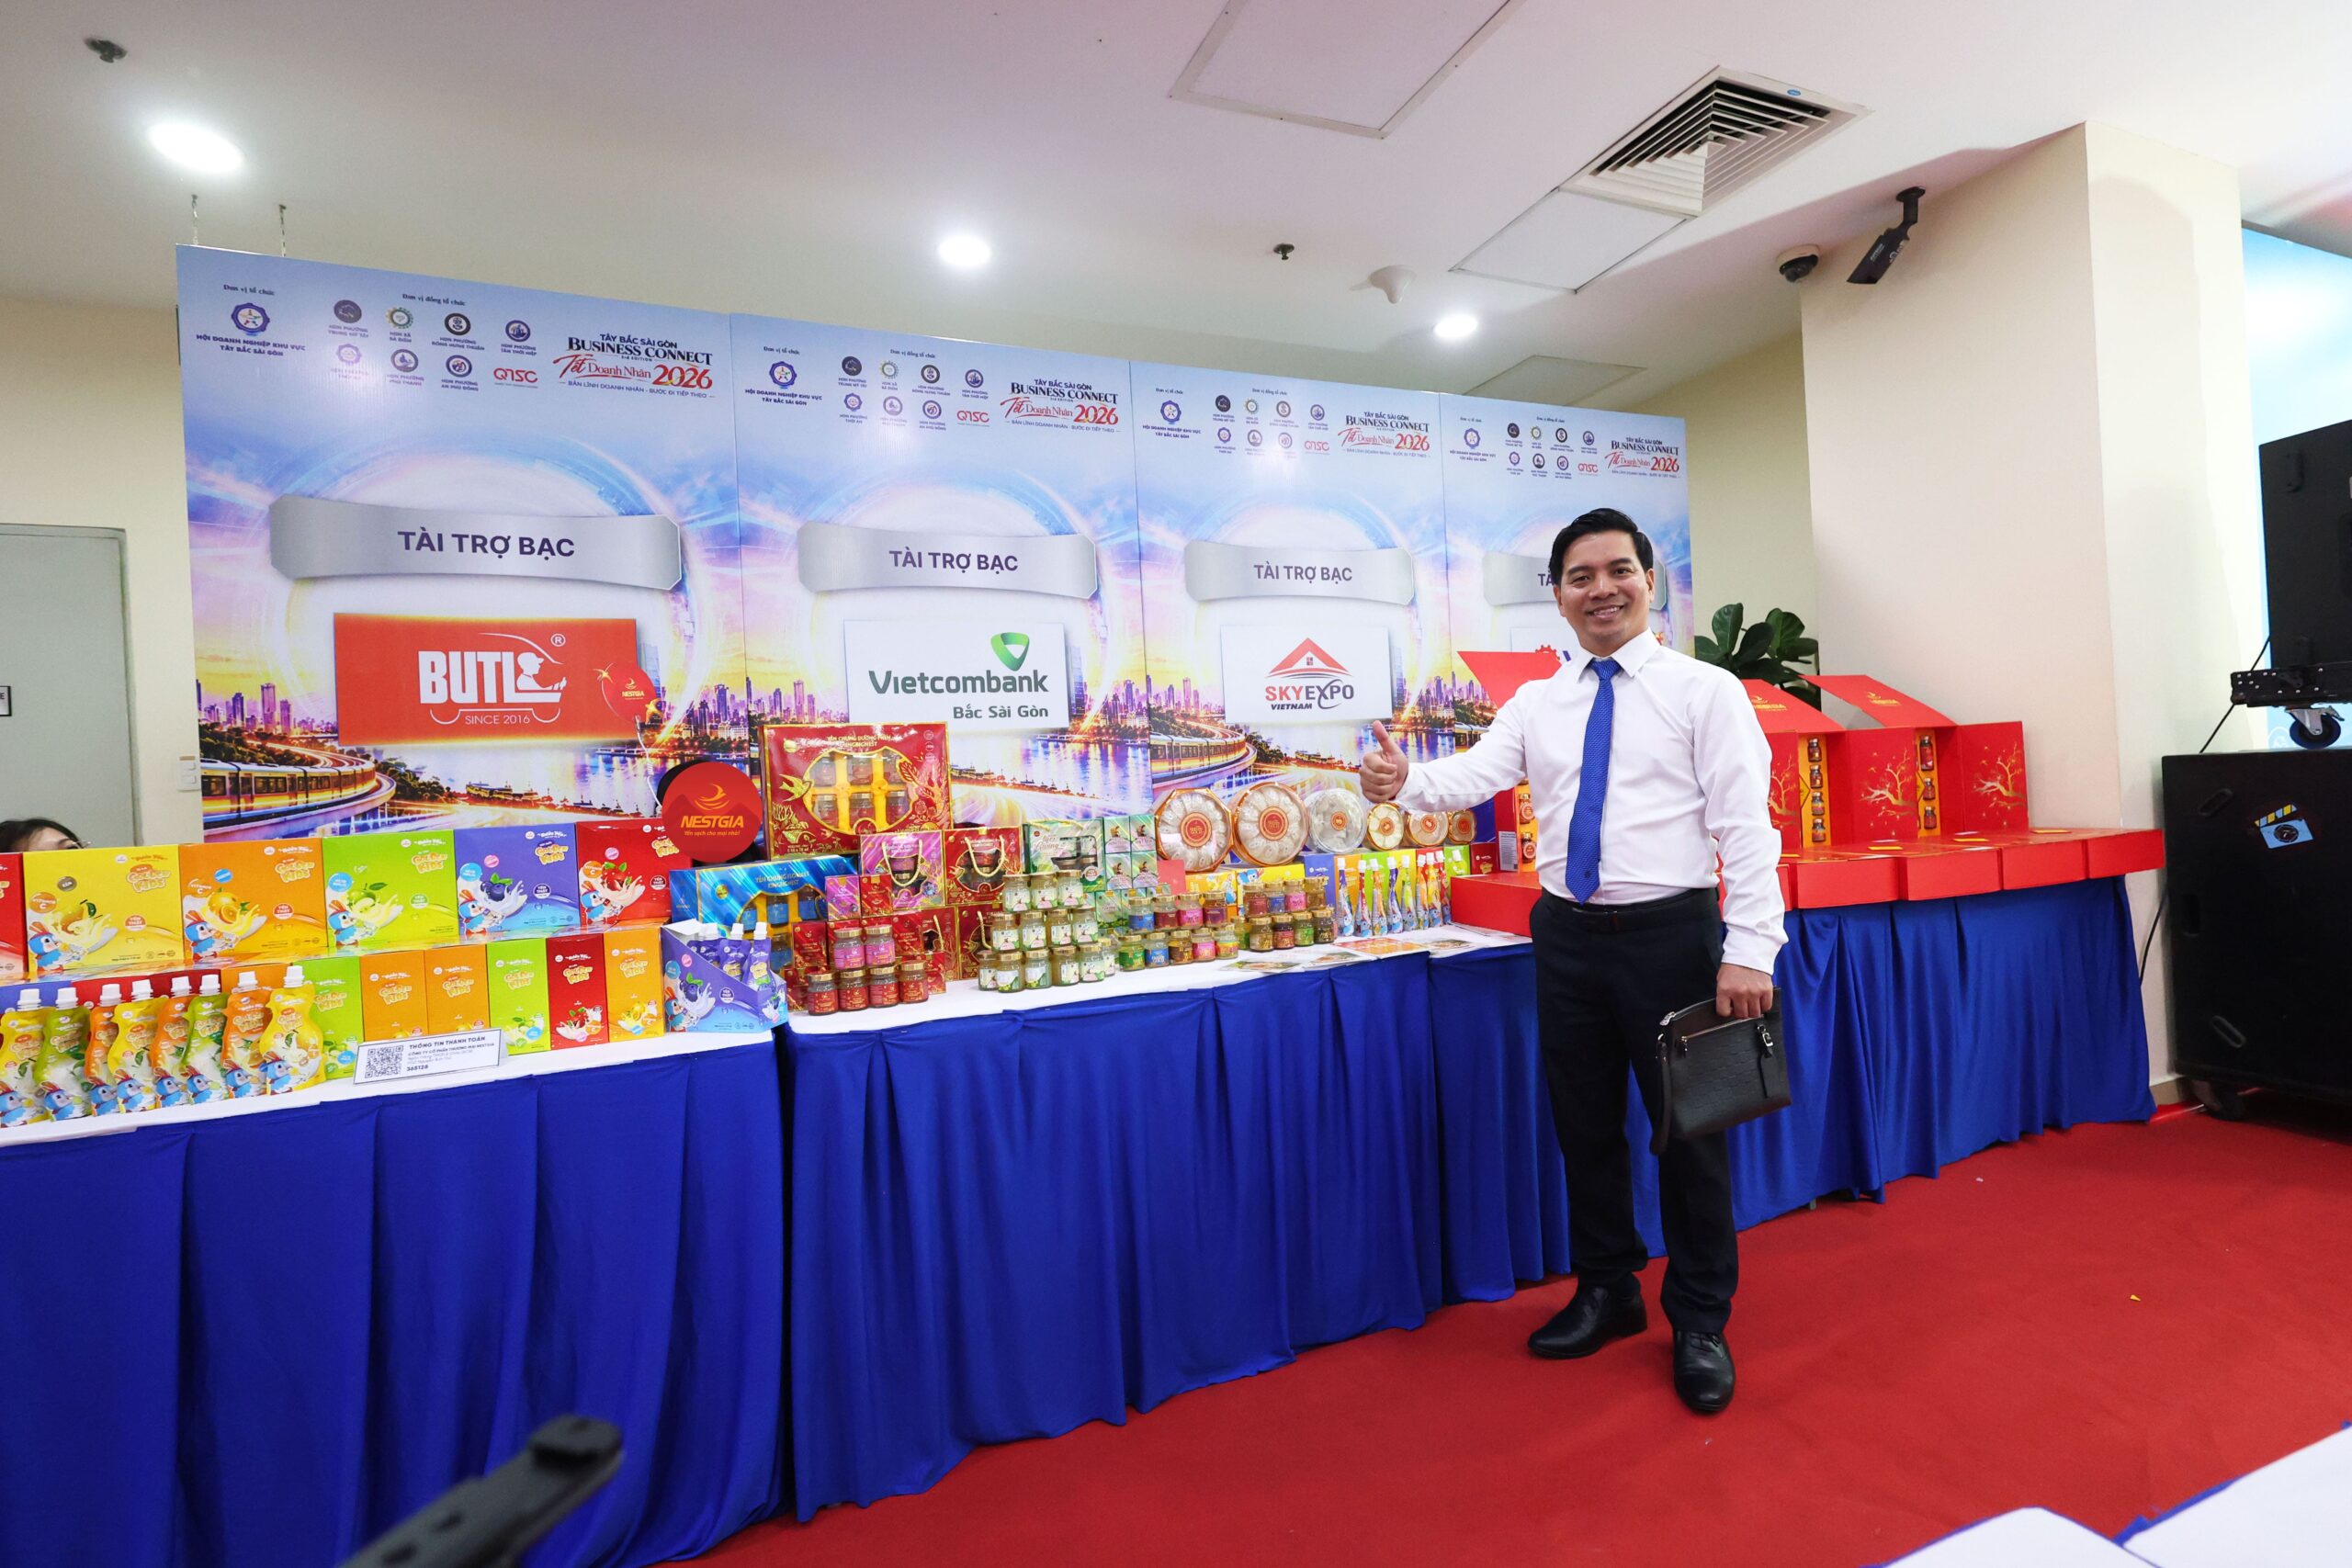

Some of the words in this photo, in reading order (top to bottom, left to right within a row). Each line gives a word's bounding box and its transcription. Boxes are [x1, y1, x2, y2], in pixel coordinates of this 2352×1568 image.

[237, 345, 251, 354] BẮC
[267, 348, 283, 356] GÒN
[243, 338, 270, 347] NGHIỆP
[600, 333, 617, 342] TÂY
[619, 334, 638, 344] BẮC
[640, 336, 655, 346] SÀI
[658, 338, 677, 349] GÒN
[567, 337, 641, 355] BUSINESS
[645, 346, 713, 366] CONNECT
[553, 354, 596, 378] Tết
[588, 363, 622, 376] Doanh
[624, 366, 650, 378] Nhân
[652, 364, 713, 389] 2026
[1010, 382, 1065, 398] BUSINESS
[1068, 389, 1118, 404] CONNECT
[1049, 379, 1063, 388] BẮC
[1000, 397, 1033, 418] Tết
[1026, 404, 1052, 413] Doanh
[1053, 407, 1073, 417] Nhân
[1074, 404, 1118, 424] 2026
[1346, 415, 1388, 427] BUSINESS
[1390, 420, 1430, 433] CONNECT
[1338, 427, 1363, 446] Tết
[1358, 434, 1377, 442] Doanh
[1378, 435, 1394, 444] Nhân
[1395, 434, 1430, 451] 2026
[1611, 441, 1646, 452] BUSINESS
[1647, 445, 1679, 456] CONNECT
[1637, 458, 1650, 467] Nhân
[1651, 457, 1679, 472] 2026
[398, 526, 443, 552] TÀI
[452, 534, 511, 558] TRỢ
[519, 536, 574, 560] BẠC
[889, 547, 922, 568] TÀI
[928, 552, 971, 573] TRỢ
[977, 555, 1018, 574] BẠC
[1254, 561, 1279, 580] TÀI
[1283, 566, 1317, 583] TRỢ
[1321, 568, 1352, 584] BẠC
[1538, 569, 1554, 586] TÀ
[418, 651, 561, 704] BUTL
[869, 671, 1049, 694] Vietcombank
[1265, 681, 1354, 704] SKYEXPO
[465, 715, 500, 725] SINCE
[503, 715, 530, 725] 2016
[953, 704, 982, 719] Bắc
[989, 705, 1012, 718] Sài
[1017, 705, 1048, 718] Gòn
[681, 816, 744, 829] NESTGIA
